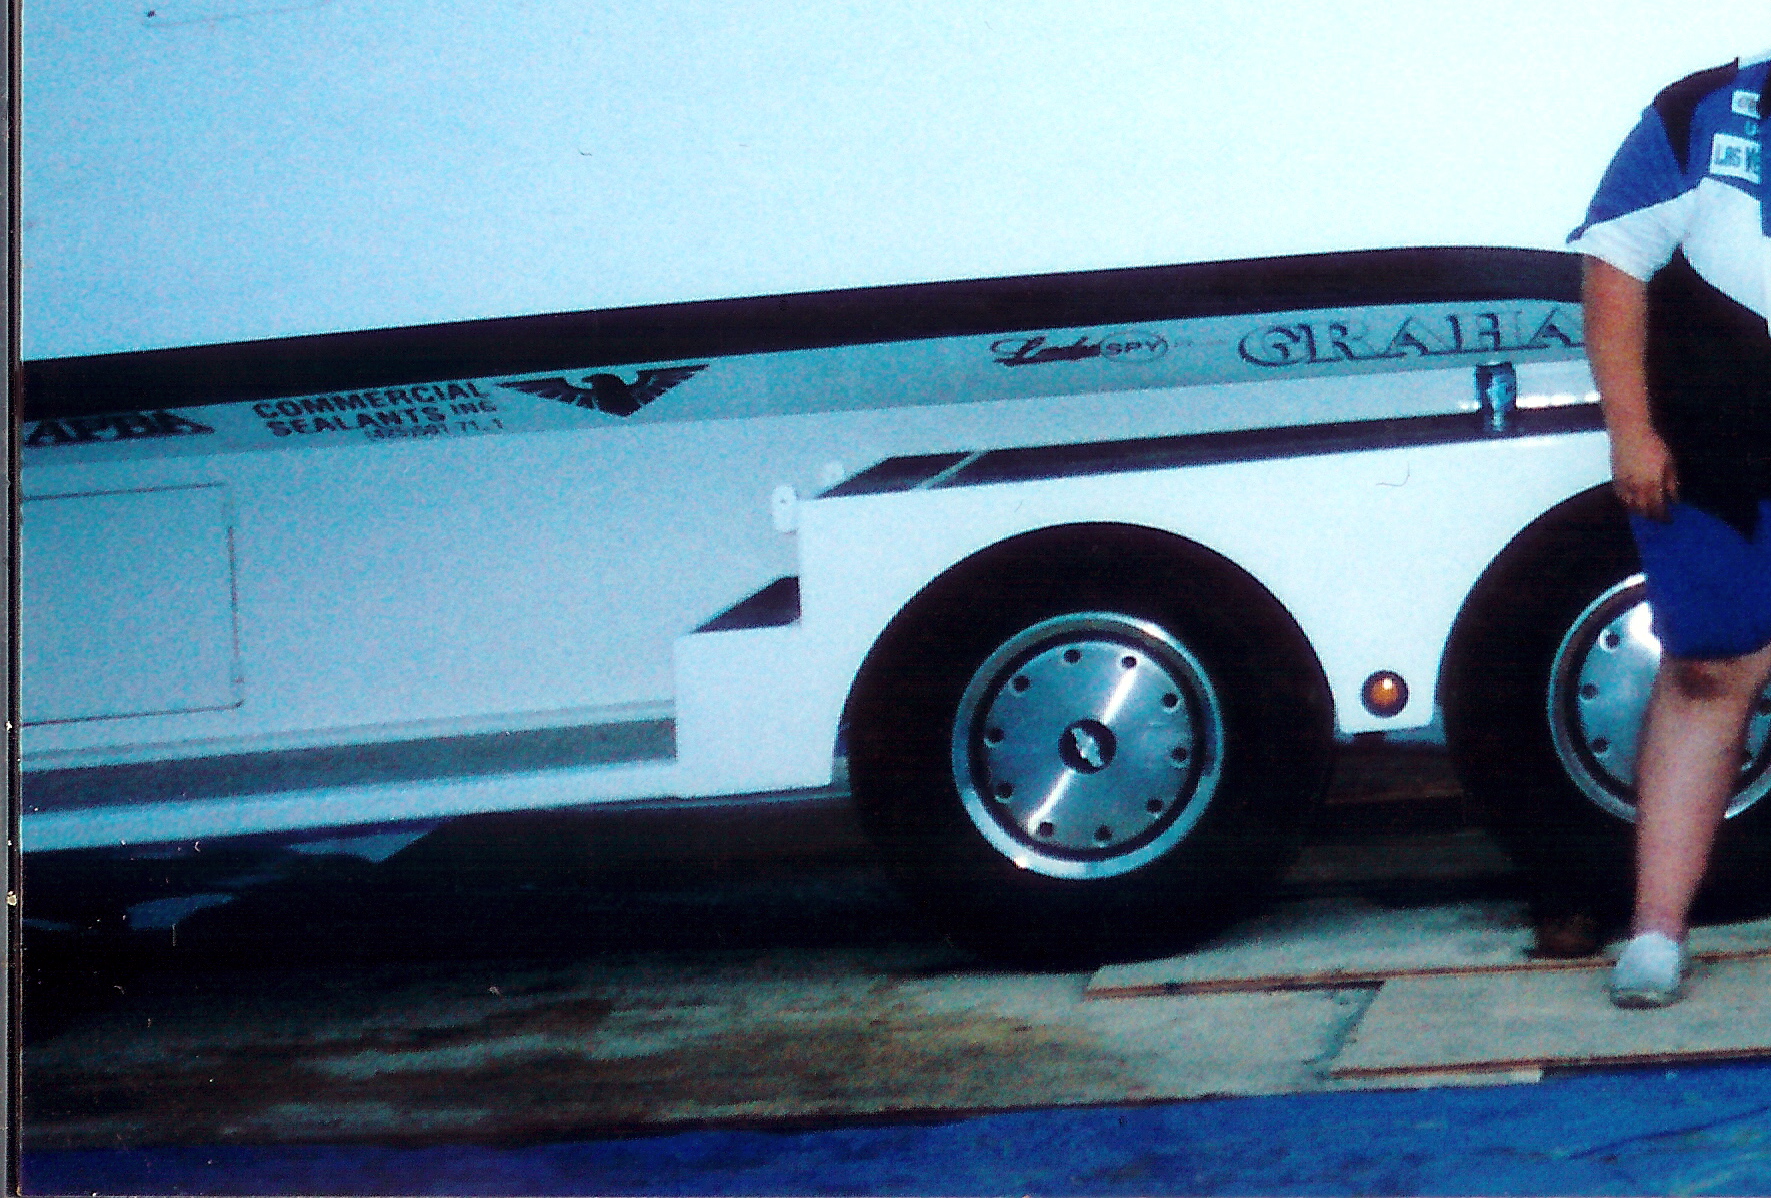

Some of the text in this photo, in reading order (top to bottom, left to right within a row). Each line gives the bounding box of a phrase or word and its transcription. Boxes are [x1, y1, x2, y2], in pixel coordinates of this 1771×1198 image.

[1237, 306, 1587, 368] GRAHA
[252, 382, 490, 419] COMMERCIAL
[266, 406, 447, 437] SEALANTS
